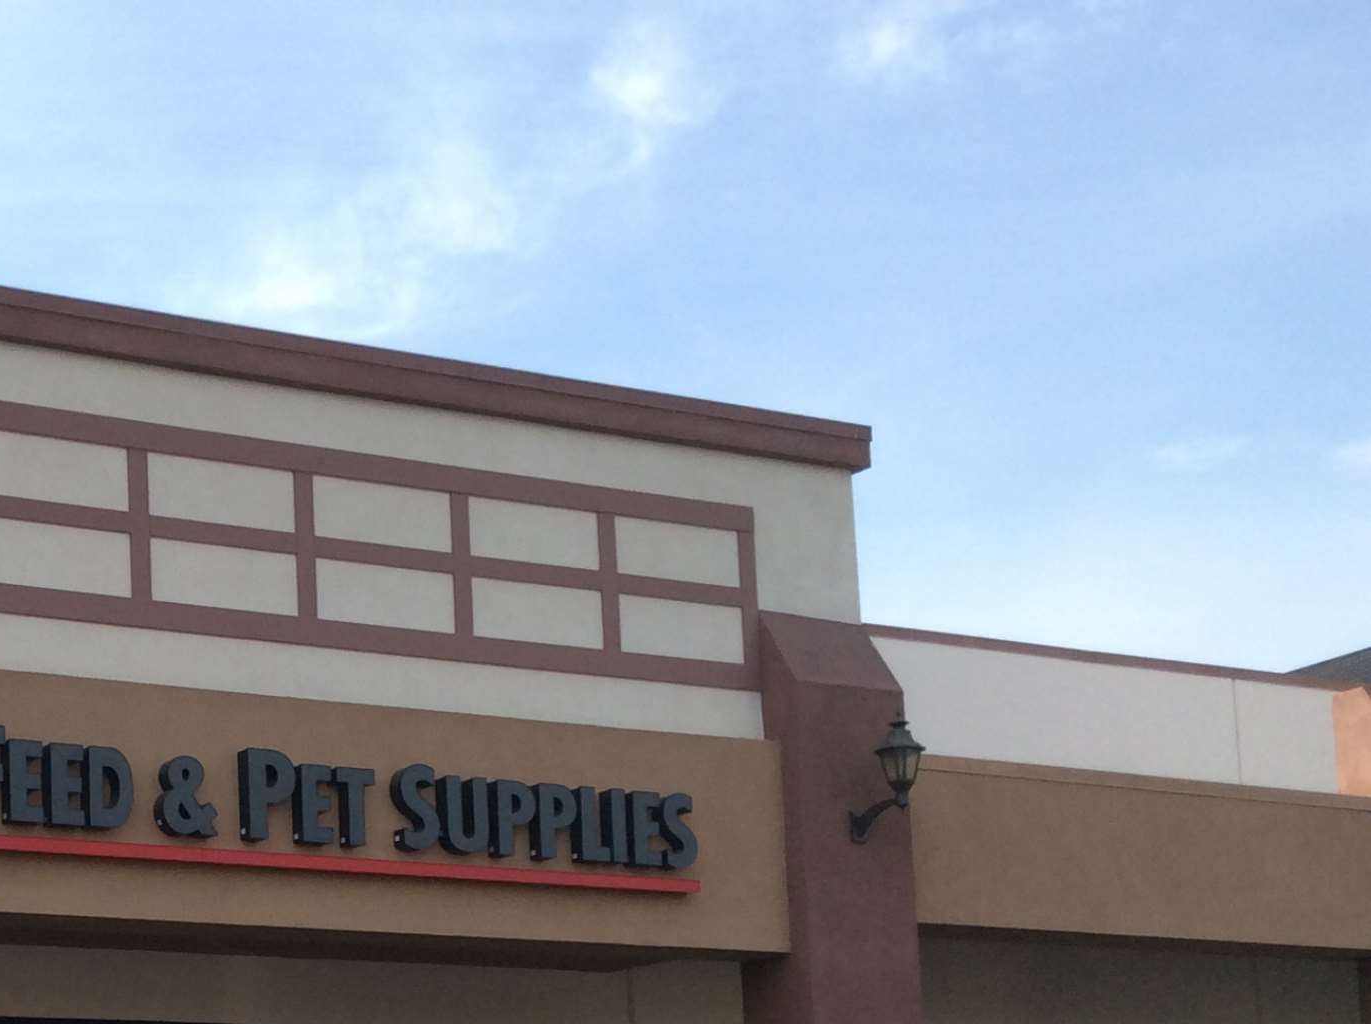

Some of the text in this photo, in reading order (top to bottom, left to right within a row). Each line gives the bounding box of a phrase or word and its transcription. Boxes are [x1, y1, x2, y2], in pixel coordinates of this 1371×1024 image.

[154, 755, 217, 840] &
[238, 747, 375, 848] PET
[391, 763, 698, 870] SUPPLIES
